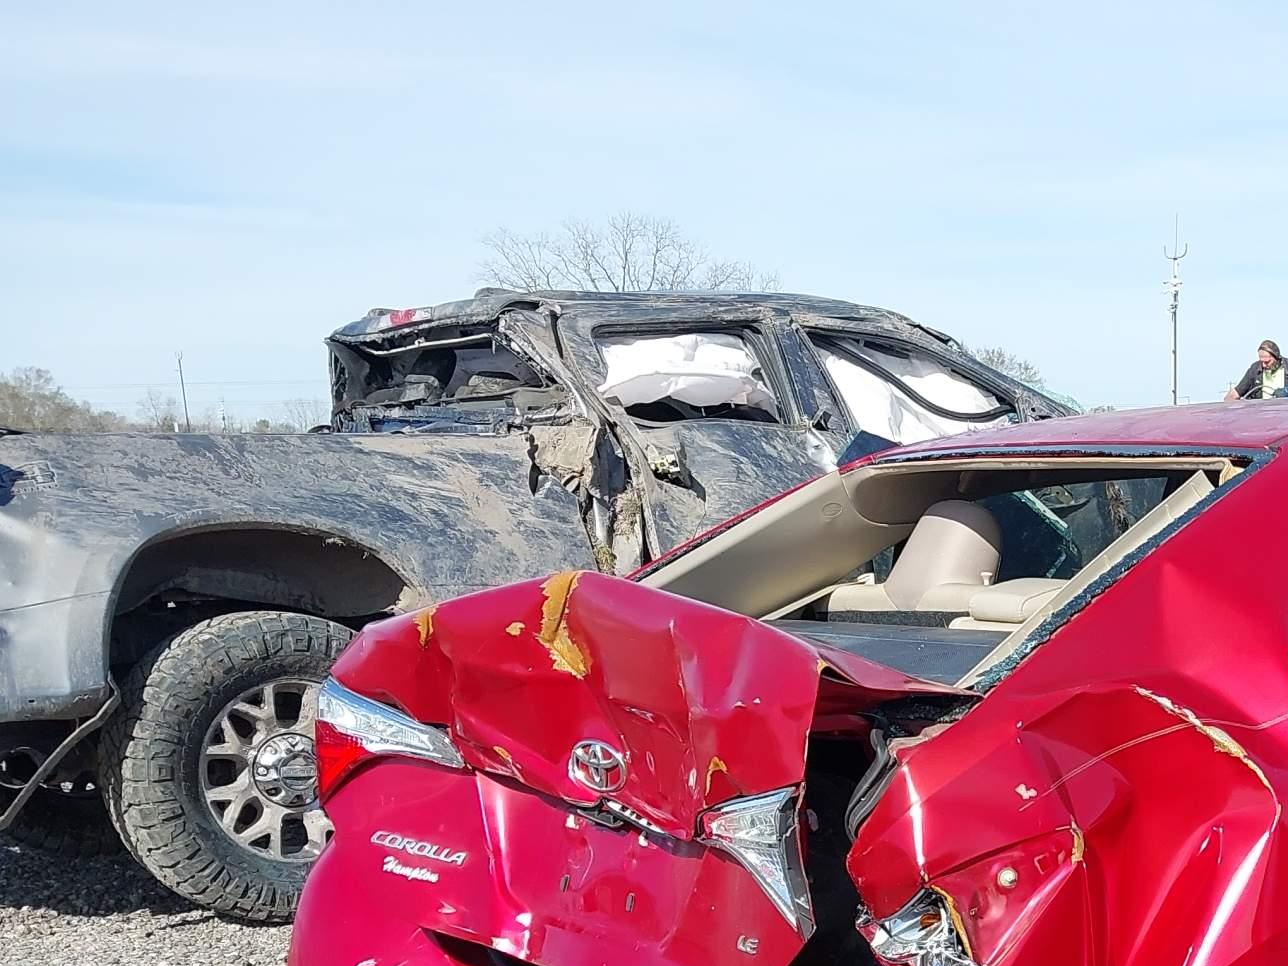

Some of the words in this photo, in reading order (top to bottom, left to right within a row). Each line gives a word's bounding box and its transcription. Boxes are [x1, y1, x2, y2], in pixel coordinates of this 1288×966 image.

[370, 830, 467, 866] COROLLA
[382, 855, 439, 883] Hampton
[736, 934, 760, 955] LE
